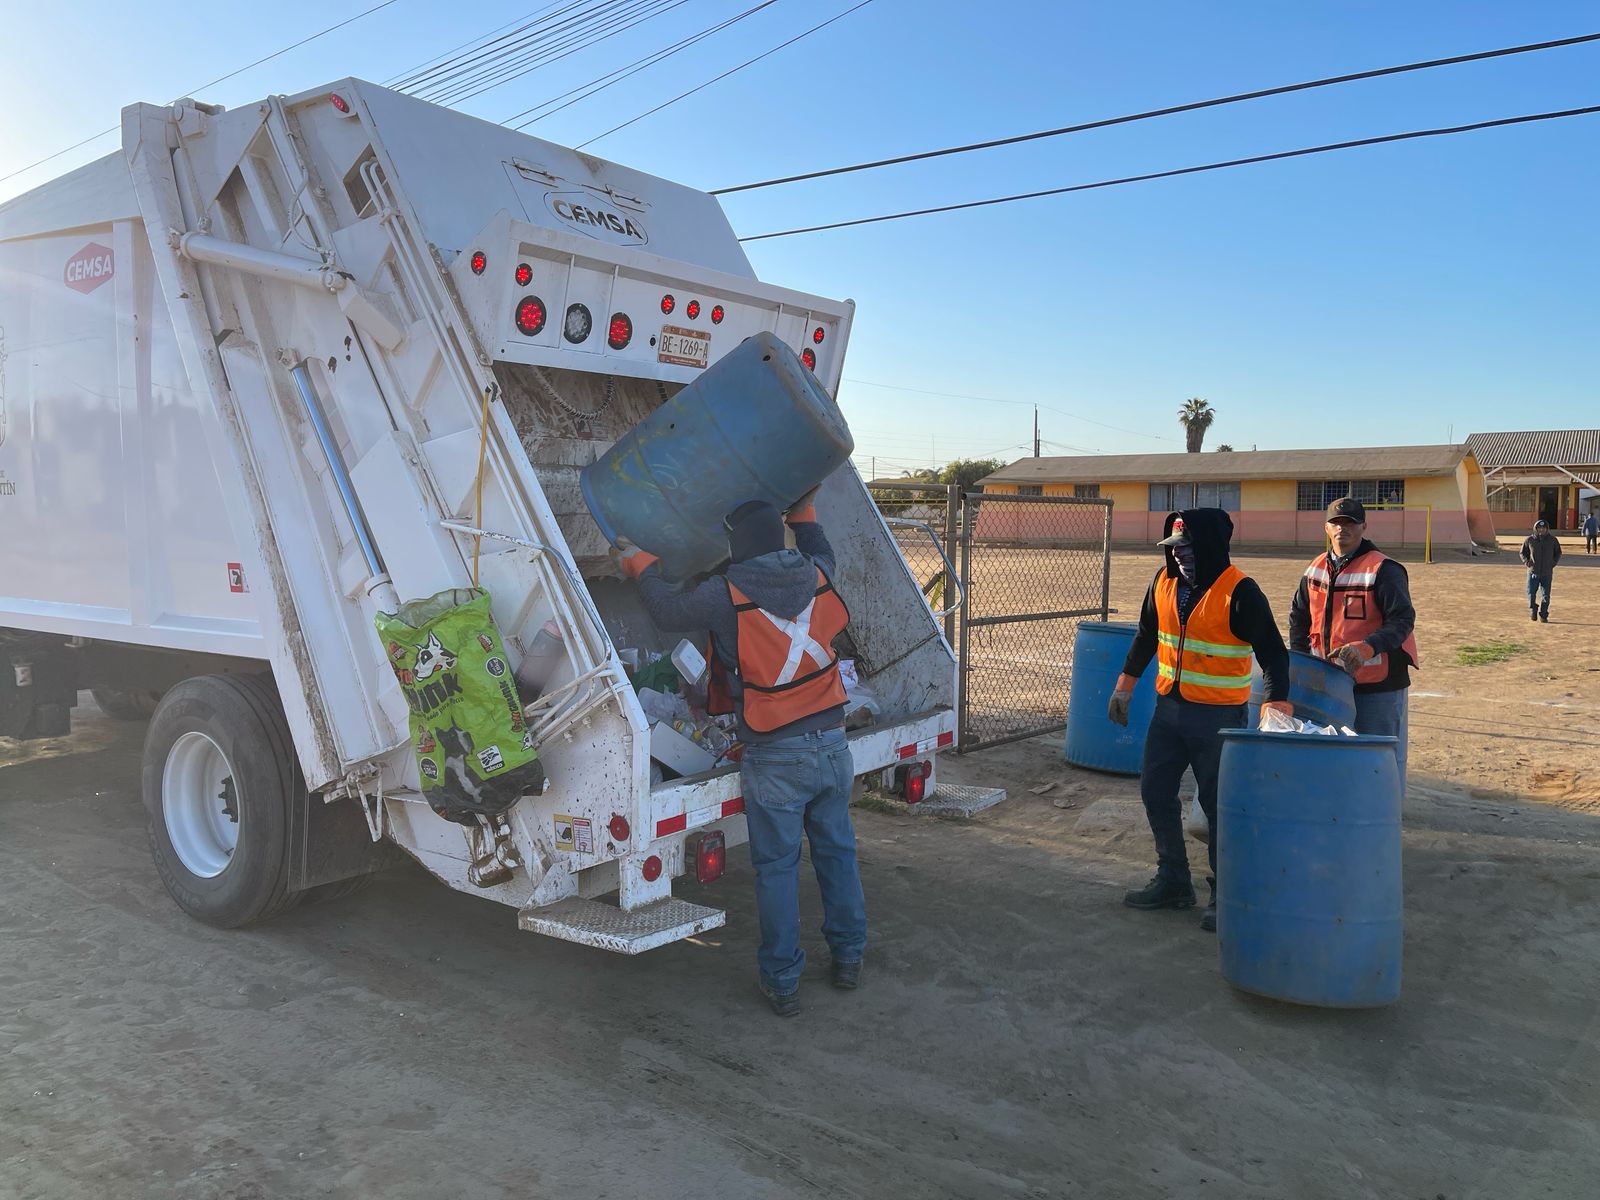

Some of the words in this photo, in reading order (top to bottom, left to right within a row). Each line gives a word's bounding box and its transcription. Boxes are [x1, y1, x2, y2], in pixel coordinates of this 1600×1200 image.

[553, 199, 643, 240] CEMSA
[67, 254, 112, 282] CEMSA
[661, 335, 709, 359] BE-1269-A
